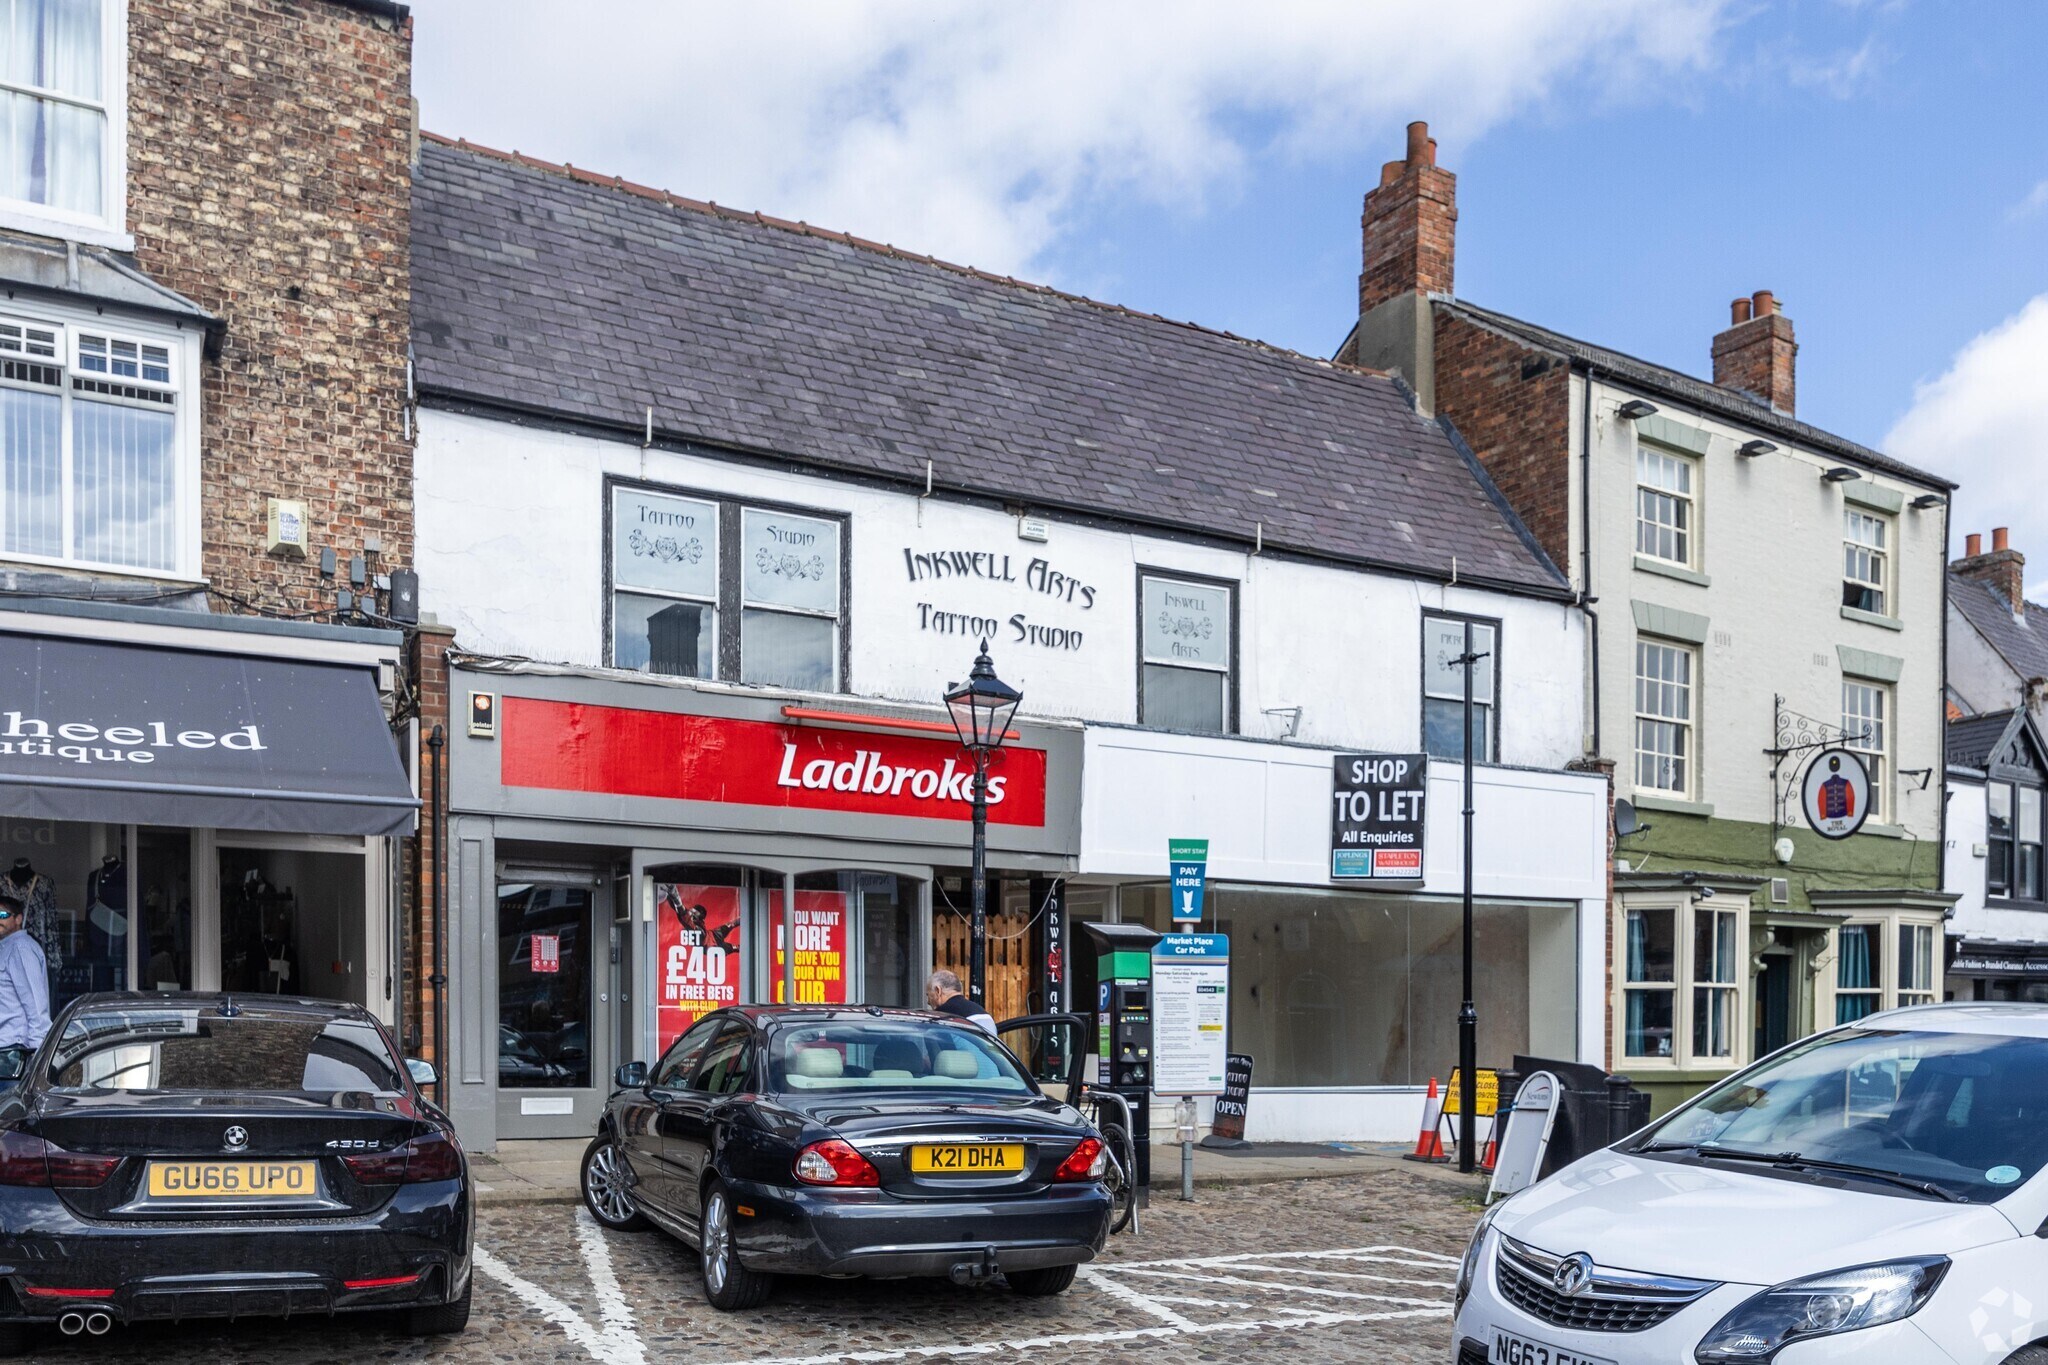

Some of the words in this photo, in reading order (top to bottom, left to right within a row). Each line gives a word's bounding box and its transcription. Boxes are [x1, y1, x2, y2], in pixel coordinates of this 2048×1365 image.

[1, 711, 268, 751] heeled
[1351, 759, 1408, 784] SHOP
[1334, 790, 1371, 822] TO
[1378, 790, 1424, 822] LET
[1341, 830, 1358, 843] All
[1360, 830, 1414, 845] Enquiries
[1378, 852, 1417, 860] STAPLETON
[1179, 867, 1198, 876] PAY
[1176, 878, 1201, 887] HERE
[794, 910, 809, 925] OU
[811, 911, 840, 926] WANT
[680, 930, 702, 946] GET
[1166, 937, 1193, 945] Market
[1193, 937, 1214, 946] Place
[1175, 946, 1188, 954] Car
[666, 945, 726, 985] £40
[795, 951, 818, 966] GIVE
[820, 952, 840, 966] YOU
[793, 966, 815, 981] OUR
[816, 966, 840, 981] OWN
[666, 984, 678, 1000] IN
[680, 985, 705, 1000] FREE
[707, 986, 734, 1001] BETS
[1100, 984, 1108, 1007] P
[680, 1001, 699, 1011] WITH
[1216, 1099, 1247, 1117] OPEN
[325, 1140, 380, 1149] 430d
[930, 1147, 963, 1168] K21
[967, 1147, 1005, 1168] DHA
[164, 1166, 240, 1190] GU66
[248, 1165, 303, 1189] UPO
